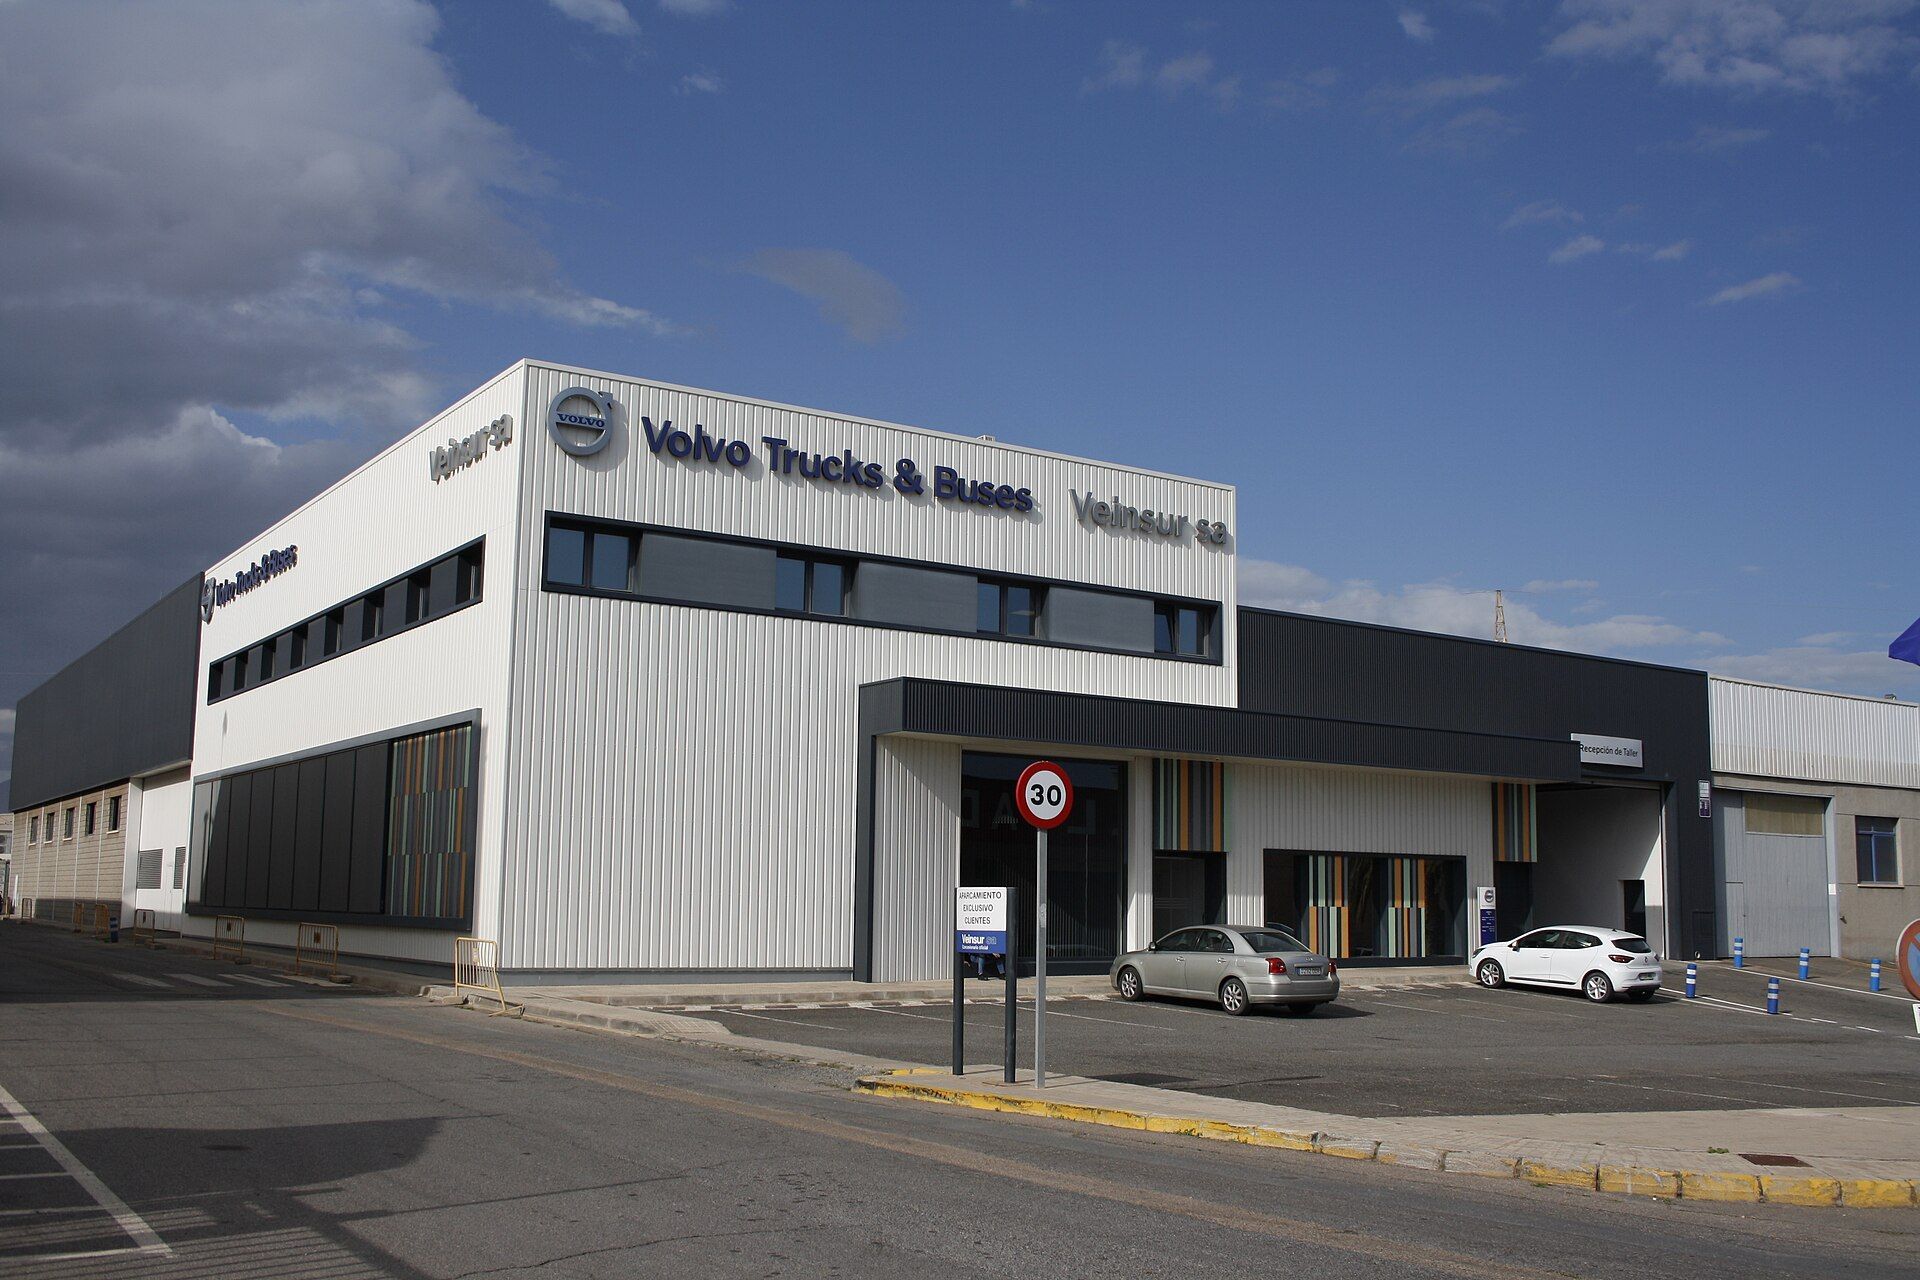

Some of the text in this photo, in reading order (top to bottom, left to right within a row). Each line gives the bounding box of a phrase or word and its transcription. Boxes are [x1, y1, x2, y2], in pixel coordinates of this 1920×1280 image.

[556, 413, 605, 428] VOLVO
[429, 414, 514, 484] Veinsur sa
[641, 416, 1033, 512] Volvo Trucks & Buses
[1068, 488, 1227, 545] Veinsur sa
[1580, 743, 1639, 758] Recepción de Taller
[1030, 783, 1062, 807] 30
[959, 891, 1002, 900] APARCAMIENTO
[962, 904, 994, 912] EXCLUSIVO
[964, 916, 991, 925] CLIENTES
